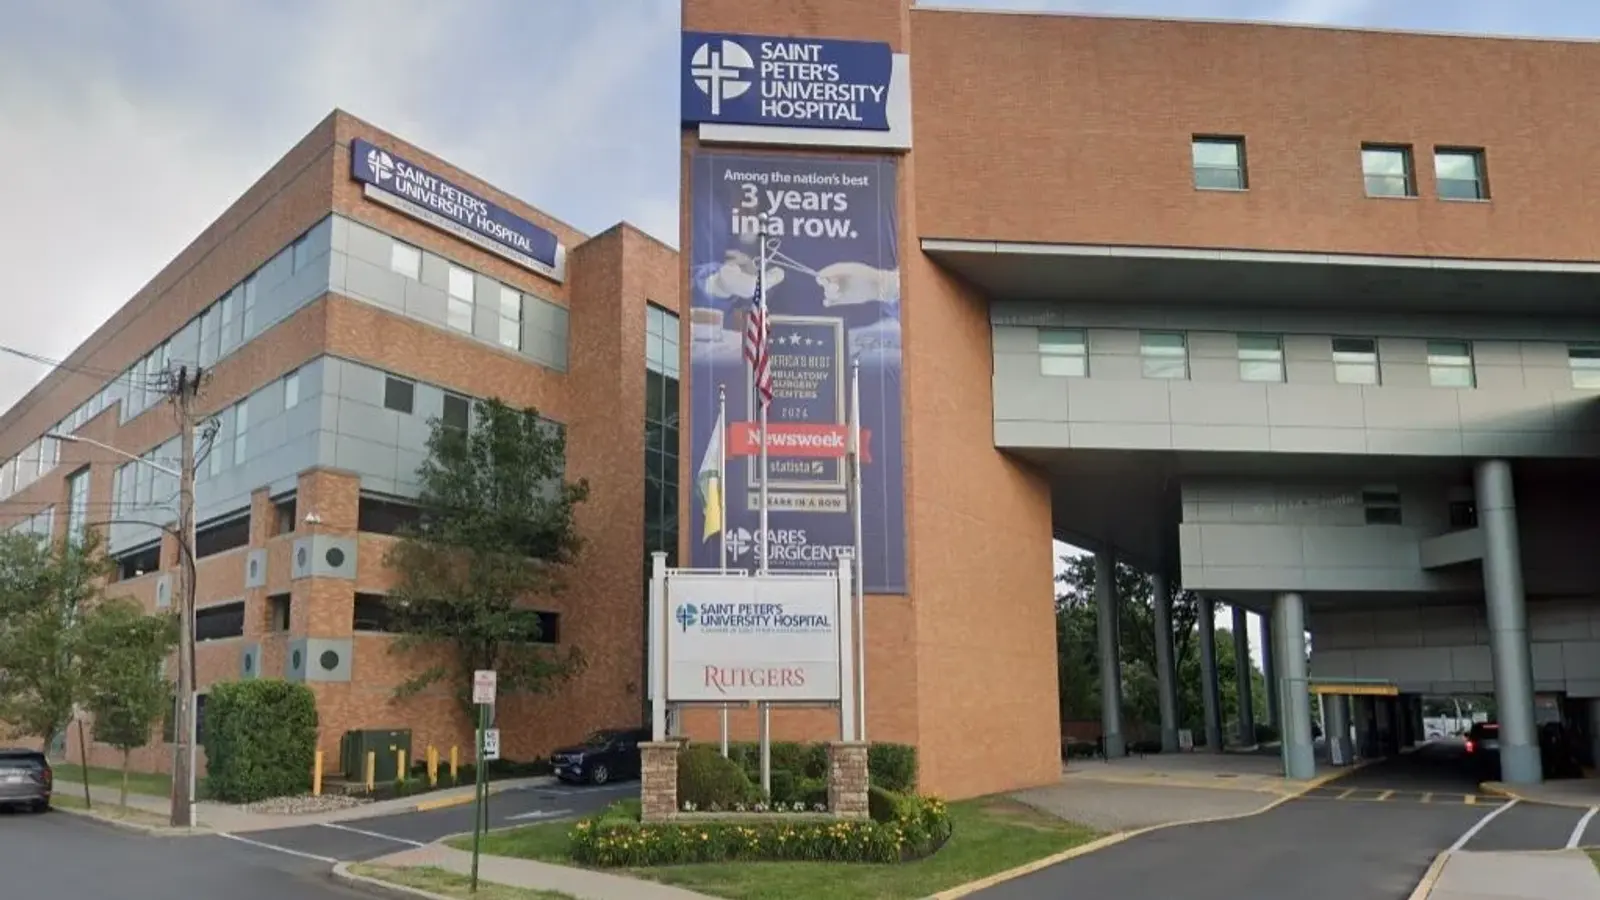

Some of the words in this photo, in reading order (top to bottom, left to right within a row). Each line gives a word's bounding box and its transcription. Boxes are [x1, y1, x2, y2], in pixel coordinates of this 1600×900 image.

[761, 42, 823, 62] SAINT
[761, 61, 840, 81] PETER'S
[761, 81, 885, 103] UNIVERSITY
[761, 100, 863, 121] HOSPITAL
[724, 169, 769, 184] Among
[770, 171, 790, 183] the
[793, 172, 840, 185] nation's
[842, 174, 869, 186] best
[396, 162, 439, 191] SAINT
[440, 183, 488, 215] PETER'S
[741, 184, 758, 208] 3
[765, 189, 848, 215] years
[396, 177, 475, 224] UNIVERSITY
[476, 216, 533, 252] HOSPITAL
[732, 208, 759, 235] in
[767, 216, 785, 236] a
[792, 217, 858, 239] row.
[769, 354, 807, 368] MERICA'S
[772, 370, 829, 381] MBULATORY
[773, 379, 818, 389] SURGERY
[773, 389, 818, 398] CENTERS
[770, 460, 810, 474] statista
[767, 496, 792, 506] EARS
[753, 529, 807, 545] CARES
[753, 543, 856, 561] SURGICENTE
[700, 603, 736, 614] SAINT
[738, 604, 783, 615] PETER'S
[700, 615, 770, 627] UNIVERSITY
[774, 616, 831, 627] HOSPITAL
